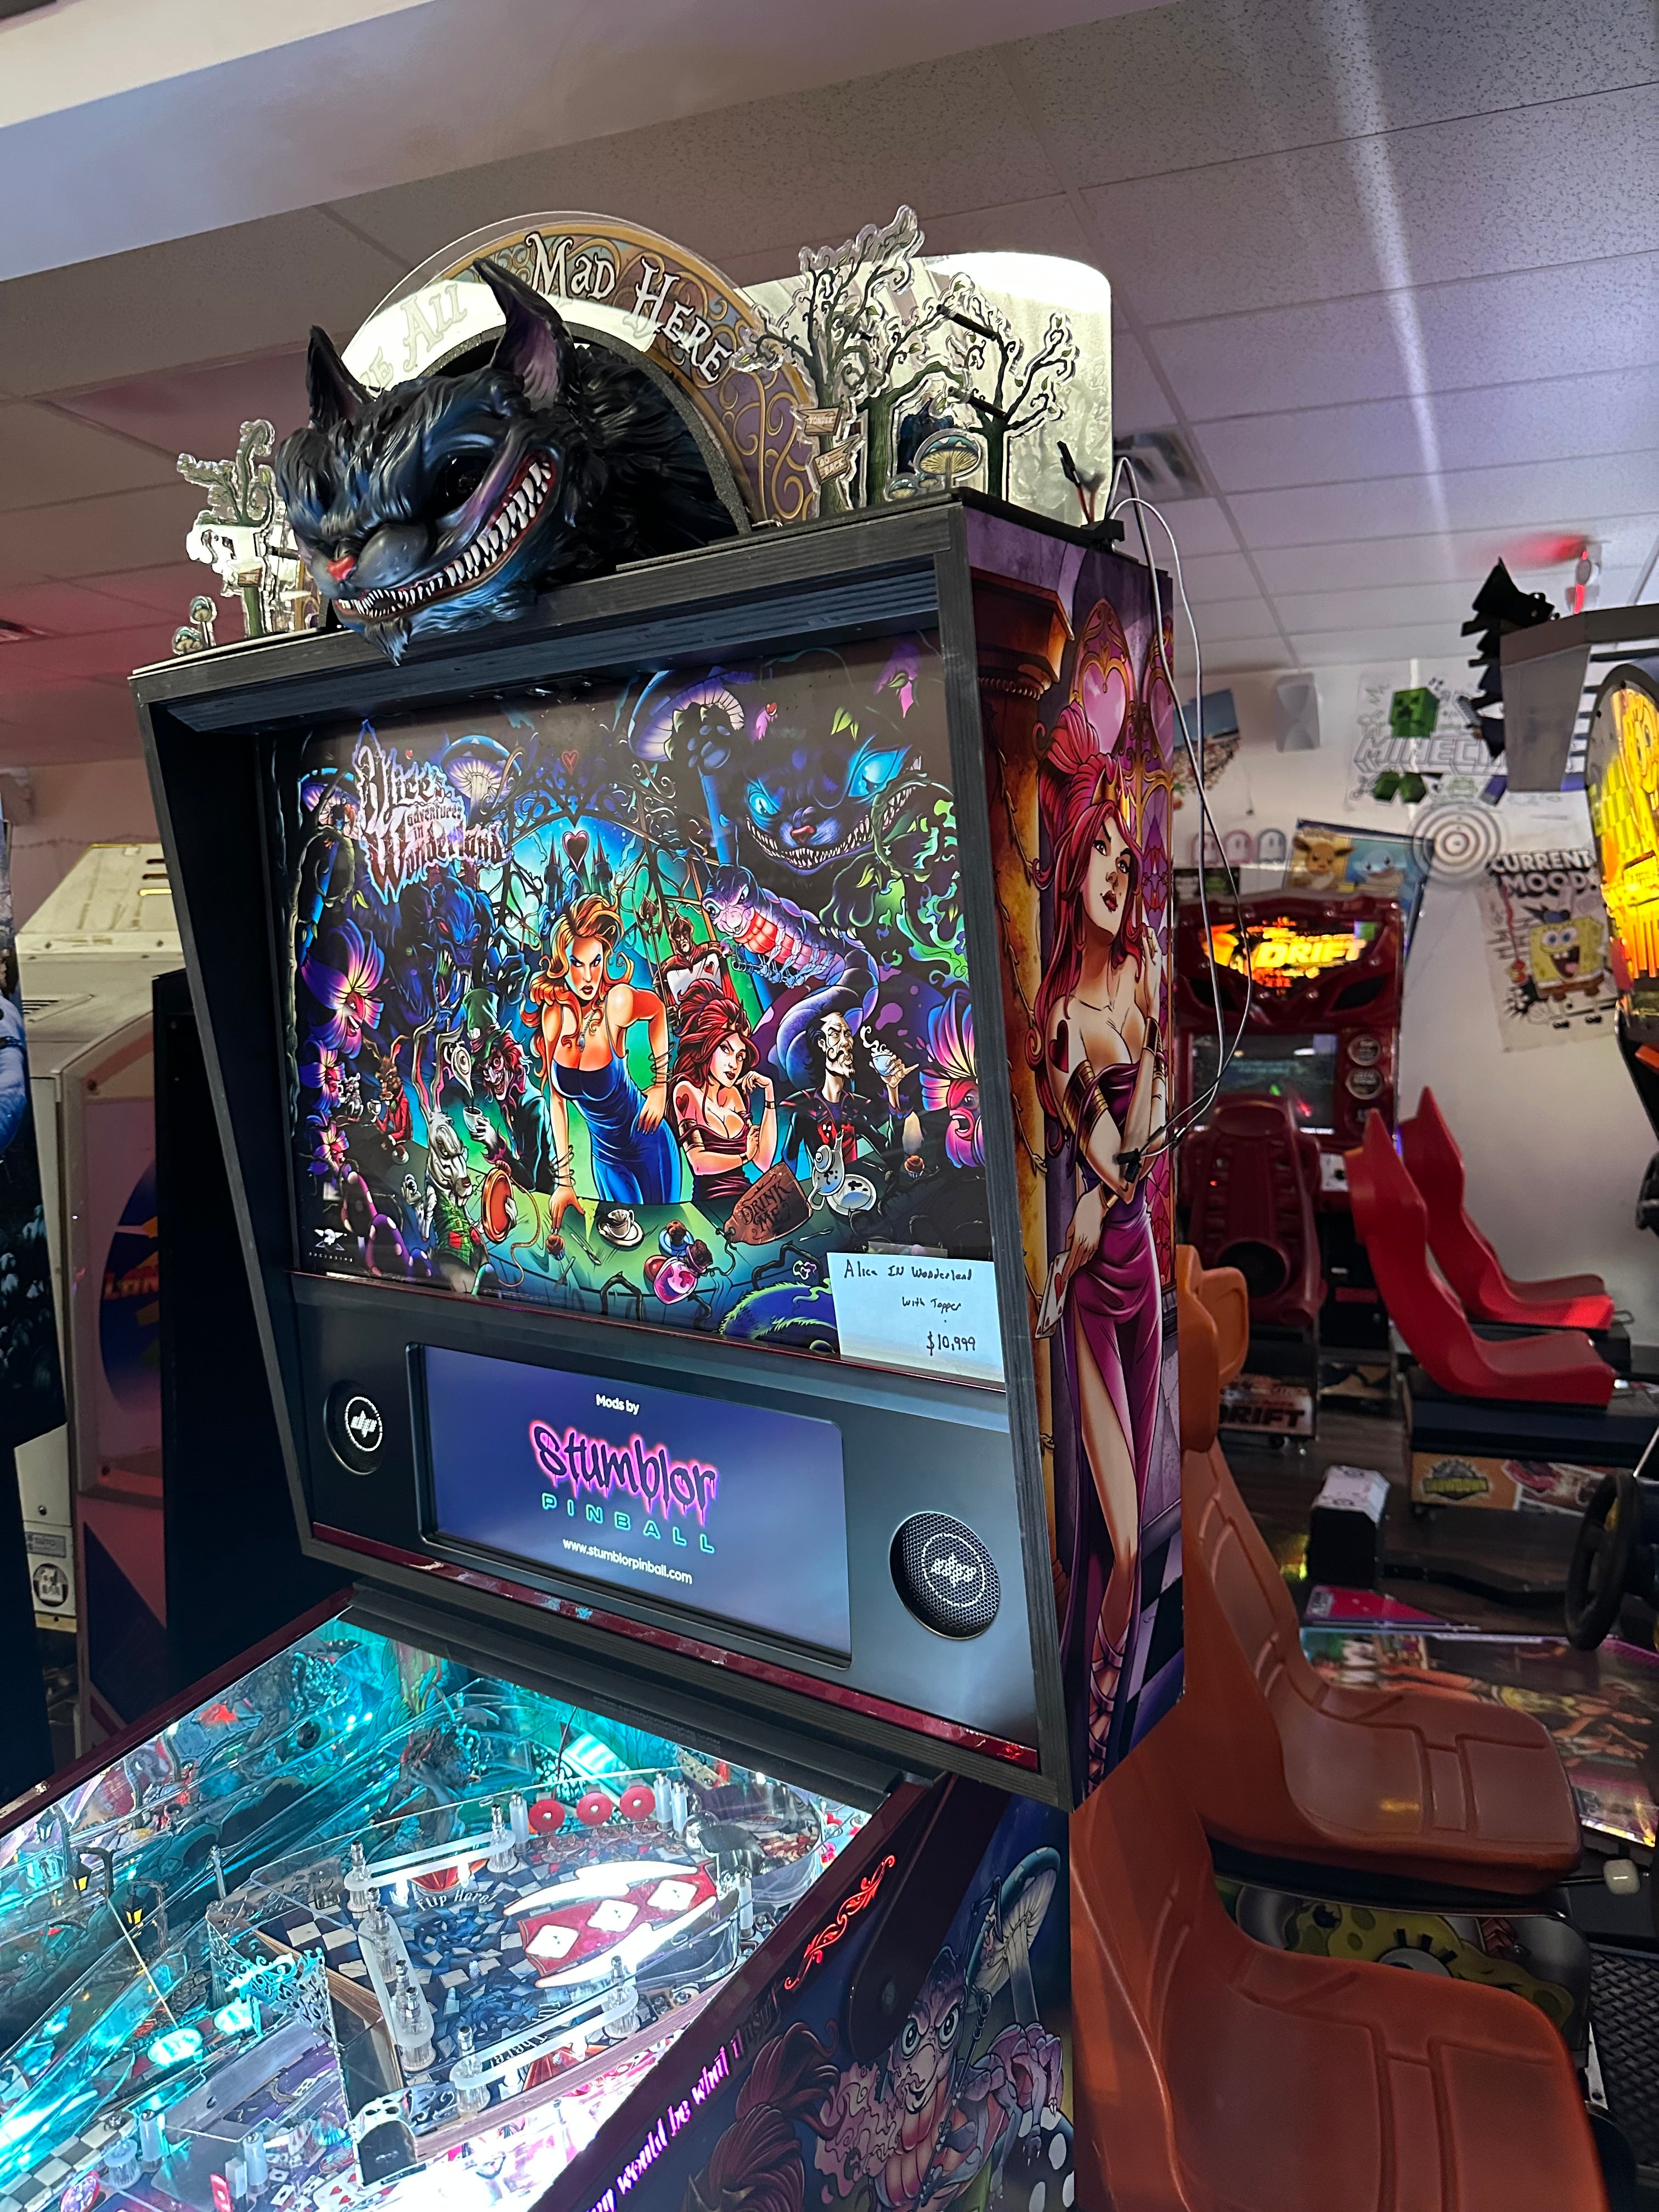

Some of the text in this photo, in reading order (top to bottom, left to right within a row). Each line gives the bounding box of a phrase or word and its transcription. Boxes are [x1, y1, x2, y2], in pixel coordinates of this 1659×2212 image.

[817, 455, 830, 466] GO
[823, 458, 845, 476] BACK
[1488, 850, 1592, 873] CURRENT
[1254, 938, 1367, 968] DRIFT
[930, 1298, 961, 1314] Topper
[926, 1330, 976, 1357] $10,999
[596, 1393, 640, 1415] Mods by
[530, 1421, 718, 1527] Stumblor
[541, 1492, 715, 1554] PINBALL
[562, 1538, 693, 1585] www.stumblorpinball.com
[667, 2104, 692, 2137] be
[690, 2045, 730, 2106] what
